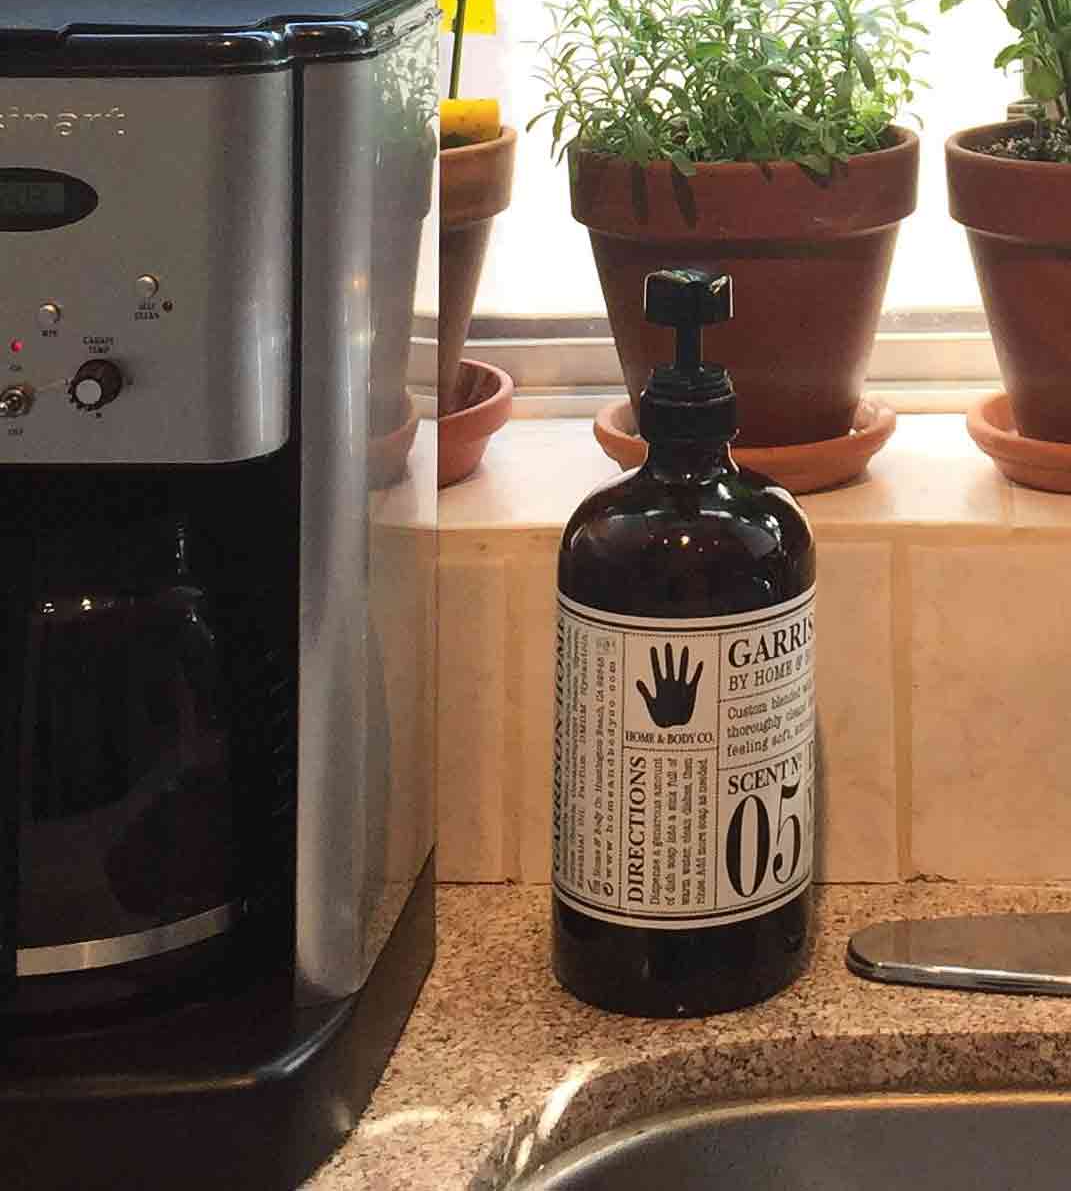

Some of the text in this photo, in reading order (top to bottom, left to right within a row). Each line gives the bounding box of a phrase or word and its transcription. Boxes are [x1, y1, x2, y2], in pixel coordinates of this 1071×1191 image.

[728, 673, 749, 691] BY
[754, 659, 793, 687] HOME
[625, 729, 655, 744] HOME
[656, 733, 665, 744] &
[667, 732, 696, 745] BODY
[727, 738, 769, 758] feeling
[728, 759, 789, 795] SCENT
[628, 756, 646, 903] DIRECTIONS
[727, 783, 801, 898] 05
